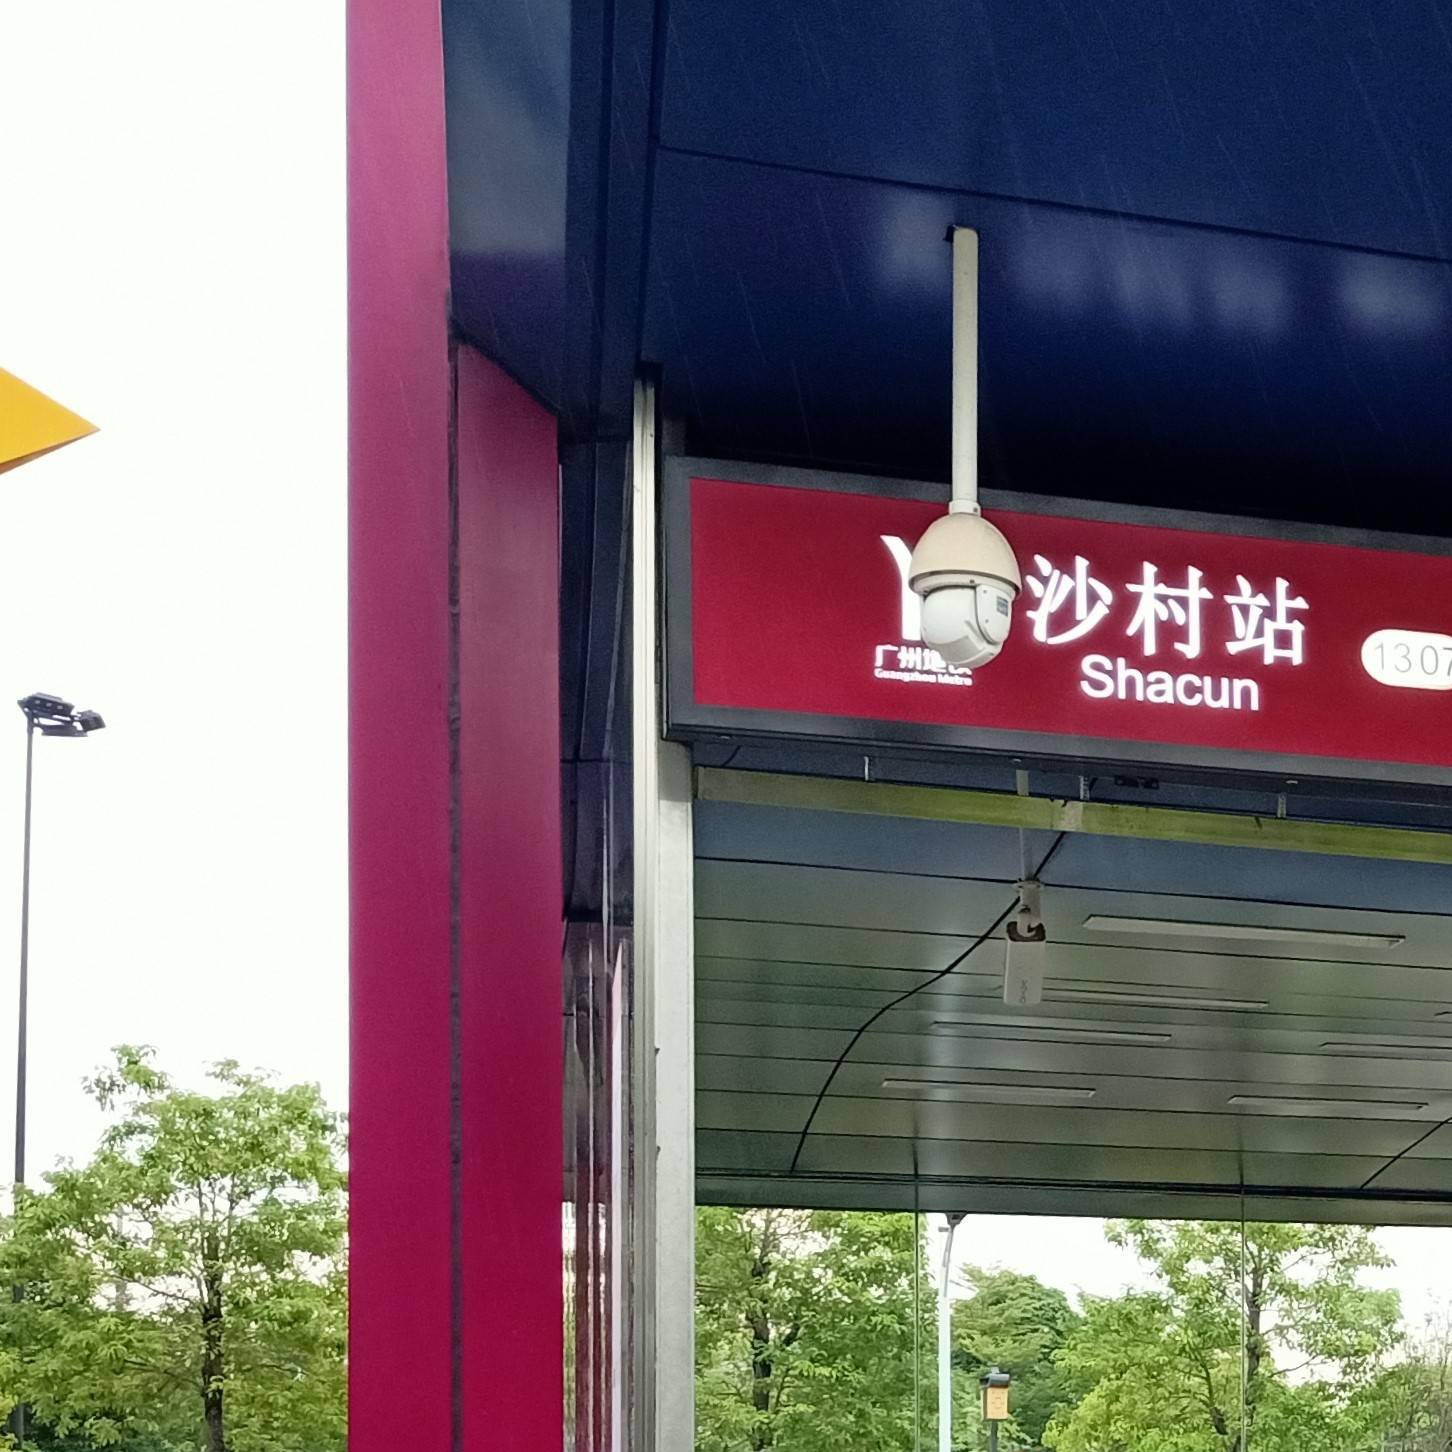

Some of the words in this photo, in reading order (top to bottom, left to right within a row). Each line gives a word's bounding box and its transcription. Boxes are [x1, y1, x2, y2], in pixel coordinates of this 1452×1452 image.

[1025, 553, 1310, 666] 沙村站
[874, 644, 972, 675] 广州地
[937, 673, 973, 686] Metro
[1080, 653, 1260, 711] Shacun
